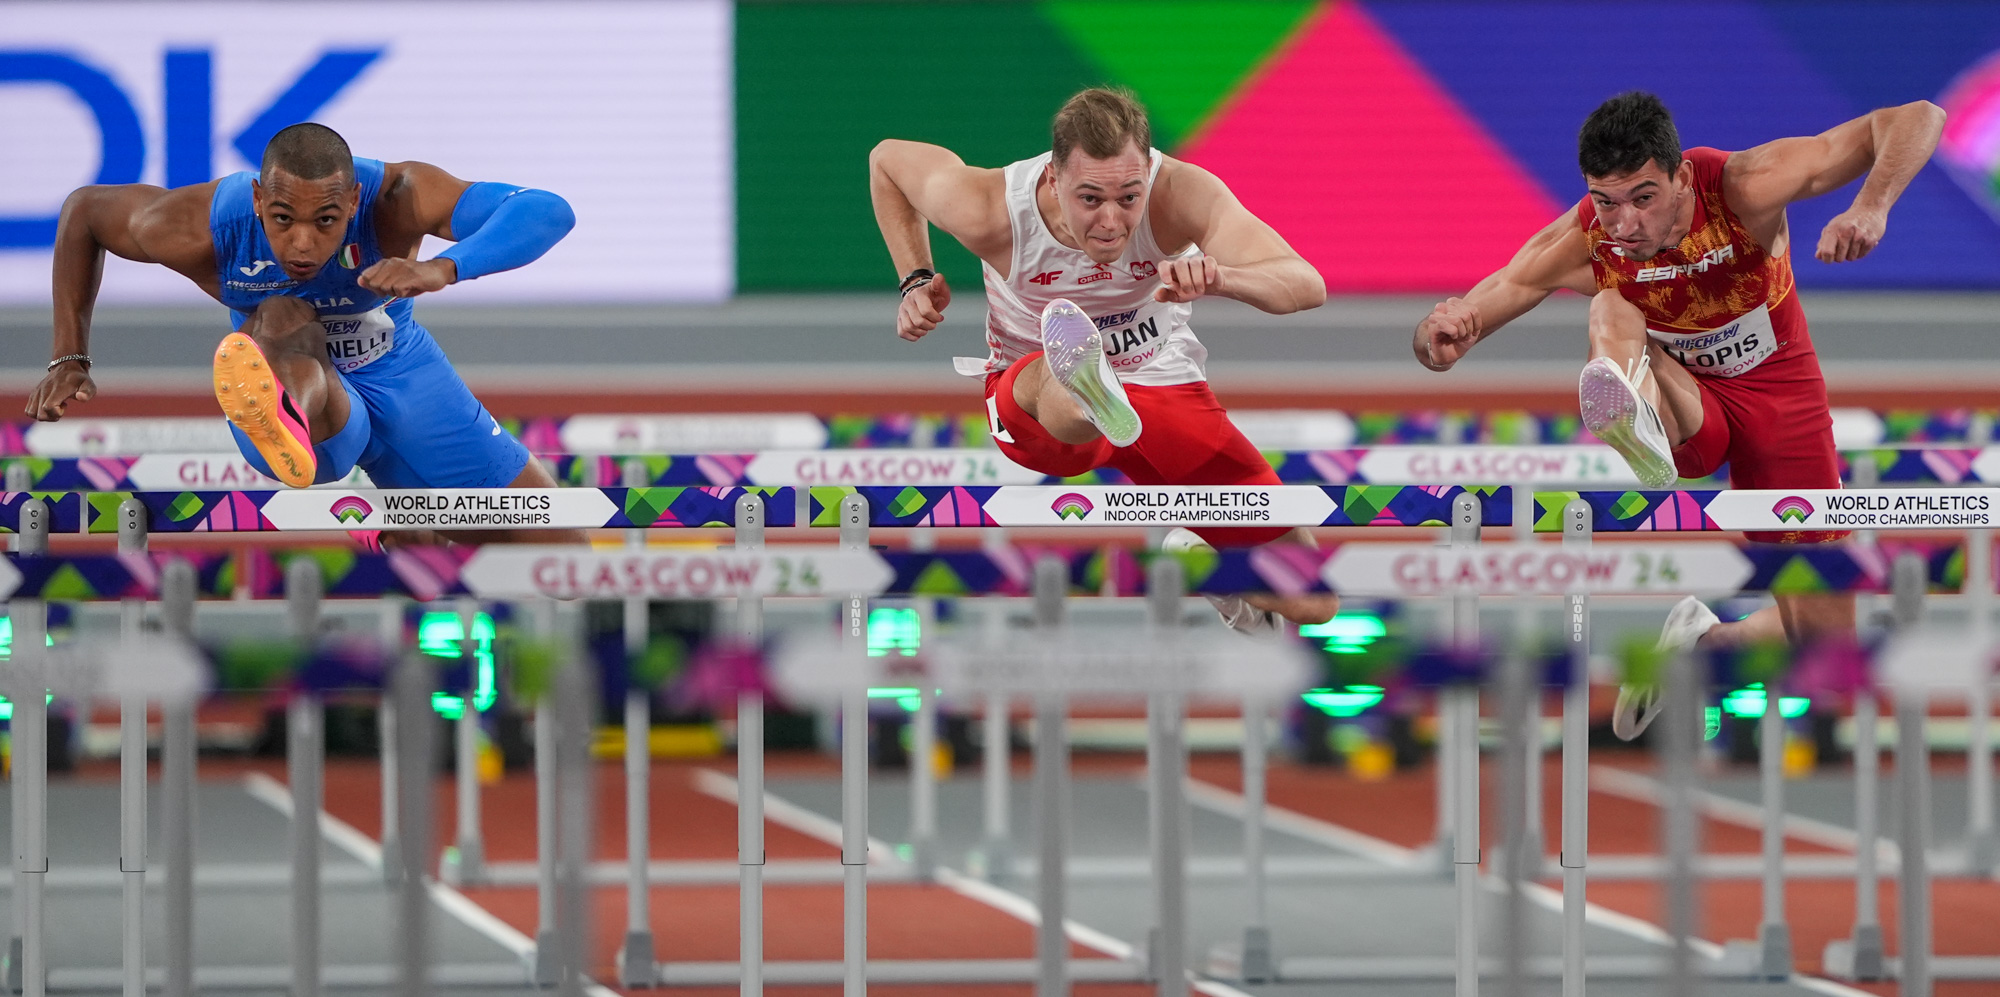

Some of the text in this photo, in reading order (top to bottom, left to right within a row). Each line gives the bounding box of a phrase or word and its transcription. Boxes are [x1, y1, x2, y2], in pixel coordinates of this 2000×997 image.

[1028, 270, 1064, 286] 4F
[1080, 271, 1112, 284] ORLEN
[1673, 323, 1740, 351] HI-CHEW
[1758, 346, 1772, 359] 24
[796, 457, 998, 483] GLASGOW 24
[1407, 453, 1609, 479] GLASGOW 24
[384, 495, 551, 510] WORLD ATHLETICS
[1104, 492, 1270, 507] WORLD ATHLETICS
[1825, 496, 1990, 510] WORLD ATHLETICS
[383, 513, 551, 525] INDOOR CHAMPIONSHIPS
[1104, 510, 1270, 521] INDOOR CHAMPIONSHIPS
[1824, 513, 1990, 525] INDOOR CHAMPIONSHIPS
[530, 555, 821, 597] GLASGOW 24
[1391, 551, 1680, 592] GLASGOW 24
[1572, 595, 1584, 642] MONDO
